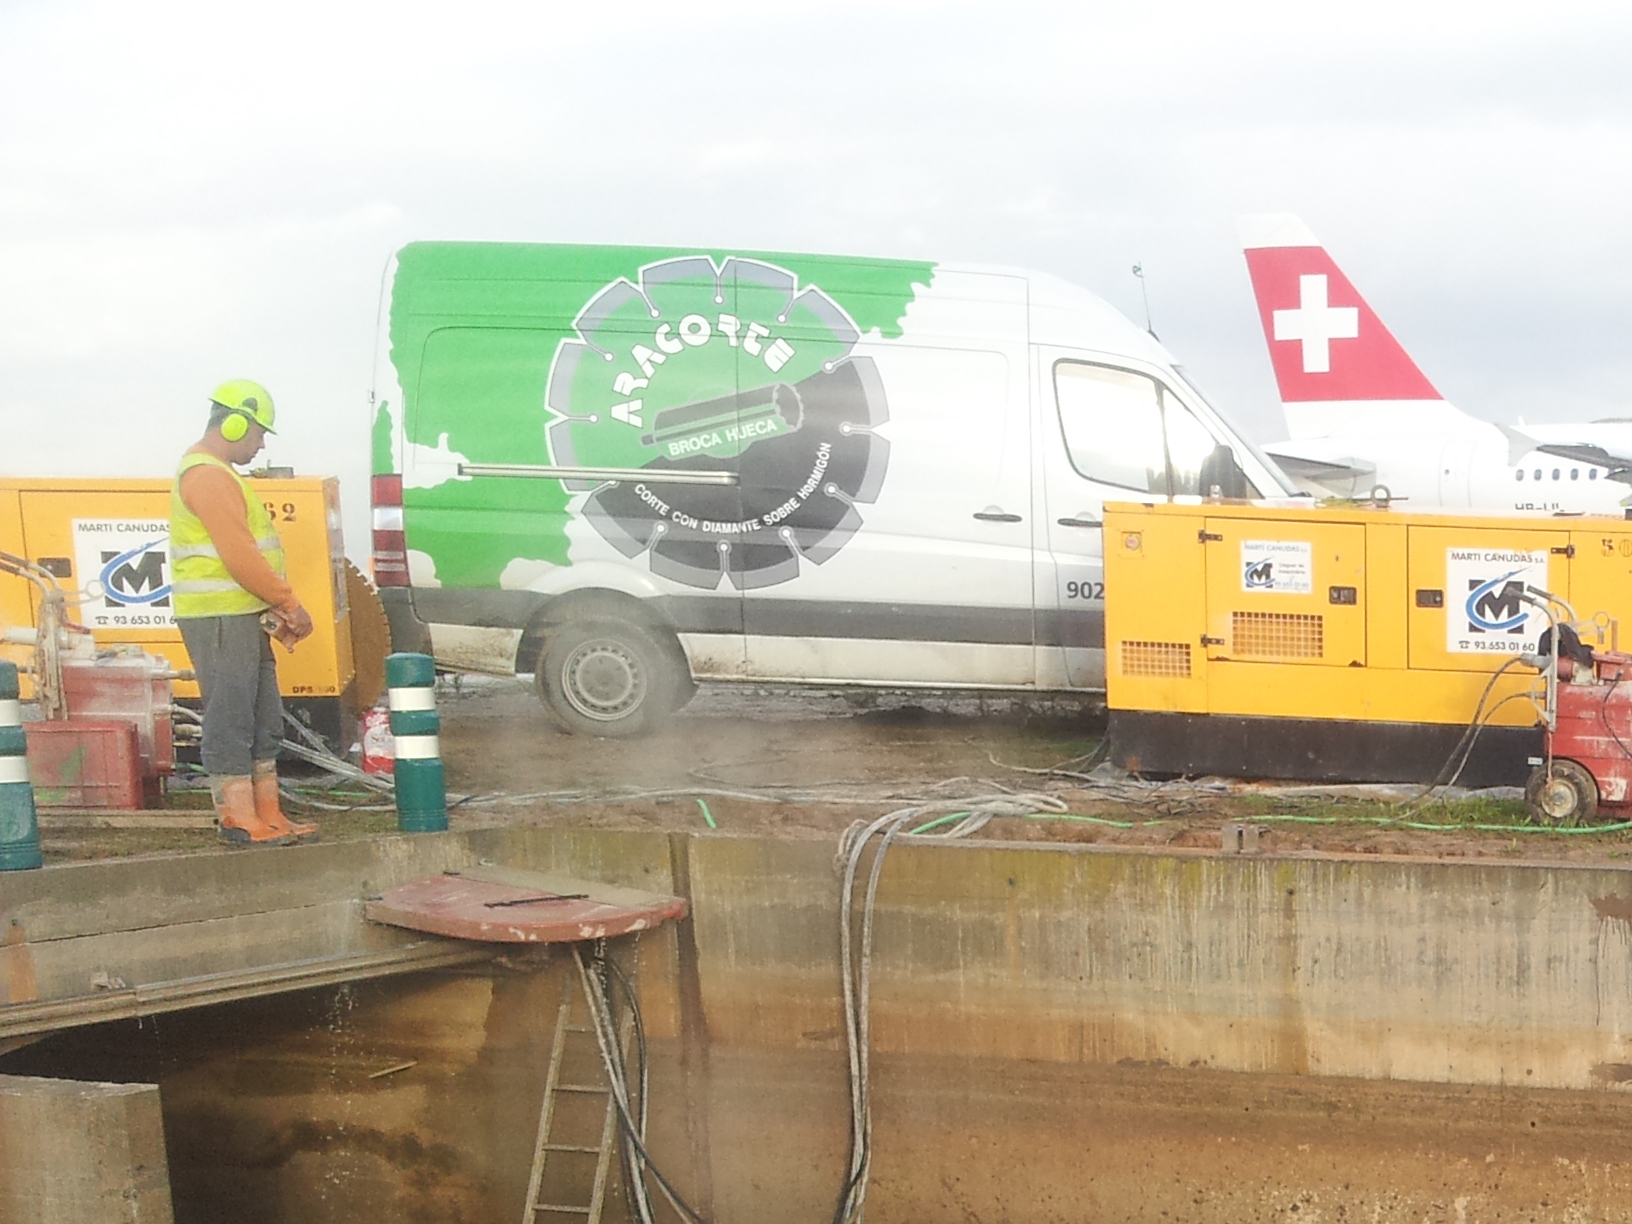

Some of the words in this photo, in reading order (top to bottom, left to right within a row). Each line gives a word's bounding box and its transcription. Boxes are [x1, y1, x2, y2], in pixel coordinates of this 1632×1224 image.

[610, 313, 796, 429] ARACORTE
[668, 433, 722, 456] BROCA
[634, 483, 670, 516] CORTE
[672, 511, 698, 530] CON
[702, 518, 761, 534] DIAMANTE
[763, 497, 801, 525] SOBRE
[797, 442, 832, 499] HORMIGÓN
[78, 523, 113, 532] MARTI
[1451, 552, 1481, 561] MARTI
[1484, 553, 1533, 563] CANUDAS
[1067, 581, 1105, 599] 902
[113, 615, 128, 624] 93
[131, 615, 150, 624] 653
[154, 616, 165, 624] 01
[1474, 641, 1486, 650] 93
[1489, 641, 1506, 650] 653
[1509, 642, 1519, 651] 01
[1522, 643, 1535, 651] 60
